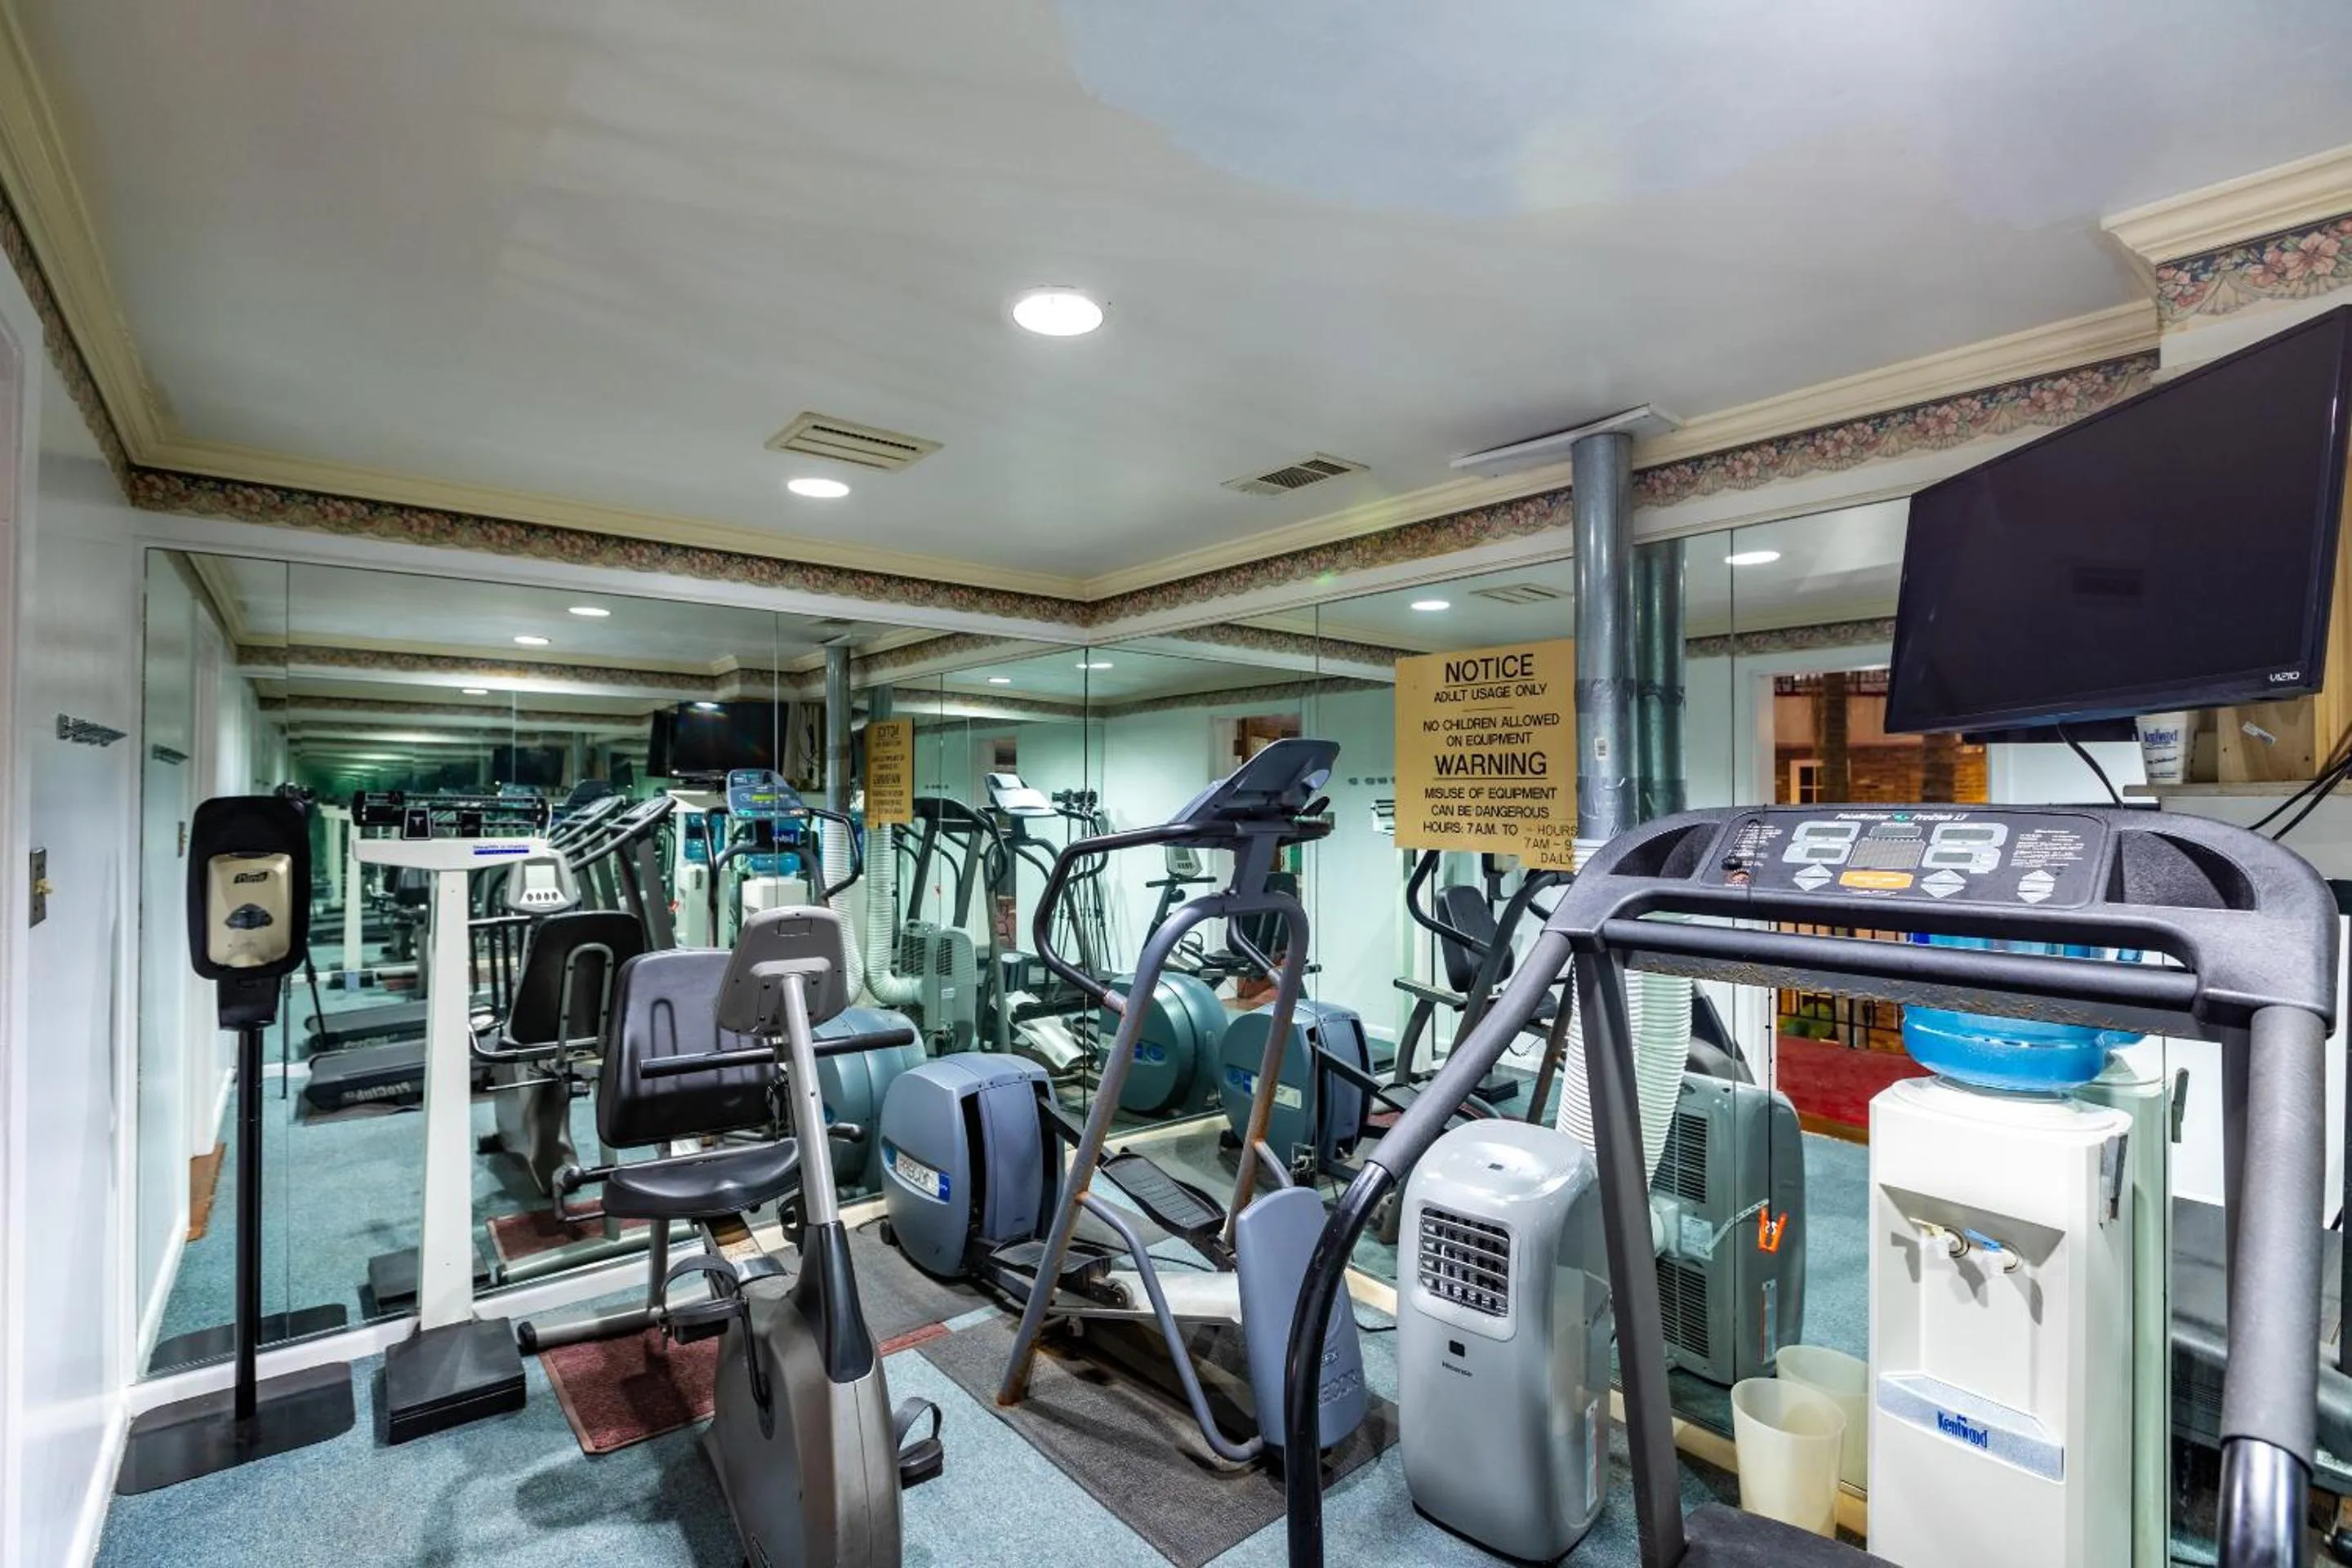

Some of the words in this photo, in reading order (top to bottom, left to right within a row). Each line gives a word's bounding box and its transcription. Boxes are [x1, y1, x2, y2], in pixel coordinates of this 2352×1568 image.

[1445, 653, 1535, 683] NOTICE
[2269, 670, 2300, 682] VIZIO
[1433, 689, 1468, 703] ADULT
[1472, 686, 1511, 700] USAGE
[1515, 684, 1548, 697] ONLY
[1423, 719, 1440, 732] NO
[1442, 717, 1497, 731] CHILDREN
[1501, 713, 1560, 728] ALLOWED
[1446, 734, 1462, 746] ON
[1466, 732, 1534, 746] EQUIPMENT
[1434, 751, 1547, 776] WARNING
[1424, 787, 1465, 799] MISUSE
[1468, 787, 1484, 798] OF
[1489, 787, 1557, 799] EQUIPMENT
[1431, 804, 1454, 816] CAN
[1458, 805, 1471, 816] BE
[1475, 805, 1549, 818] DANGEROUS
[1423, 821, 1463, 834] HOURS:
[1502, 824, 1518, 836] TO
[1538, 824, 1578, 837] HOURS
[1937, 1410, 1988, 1449] Kentwood
